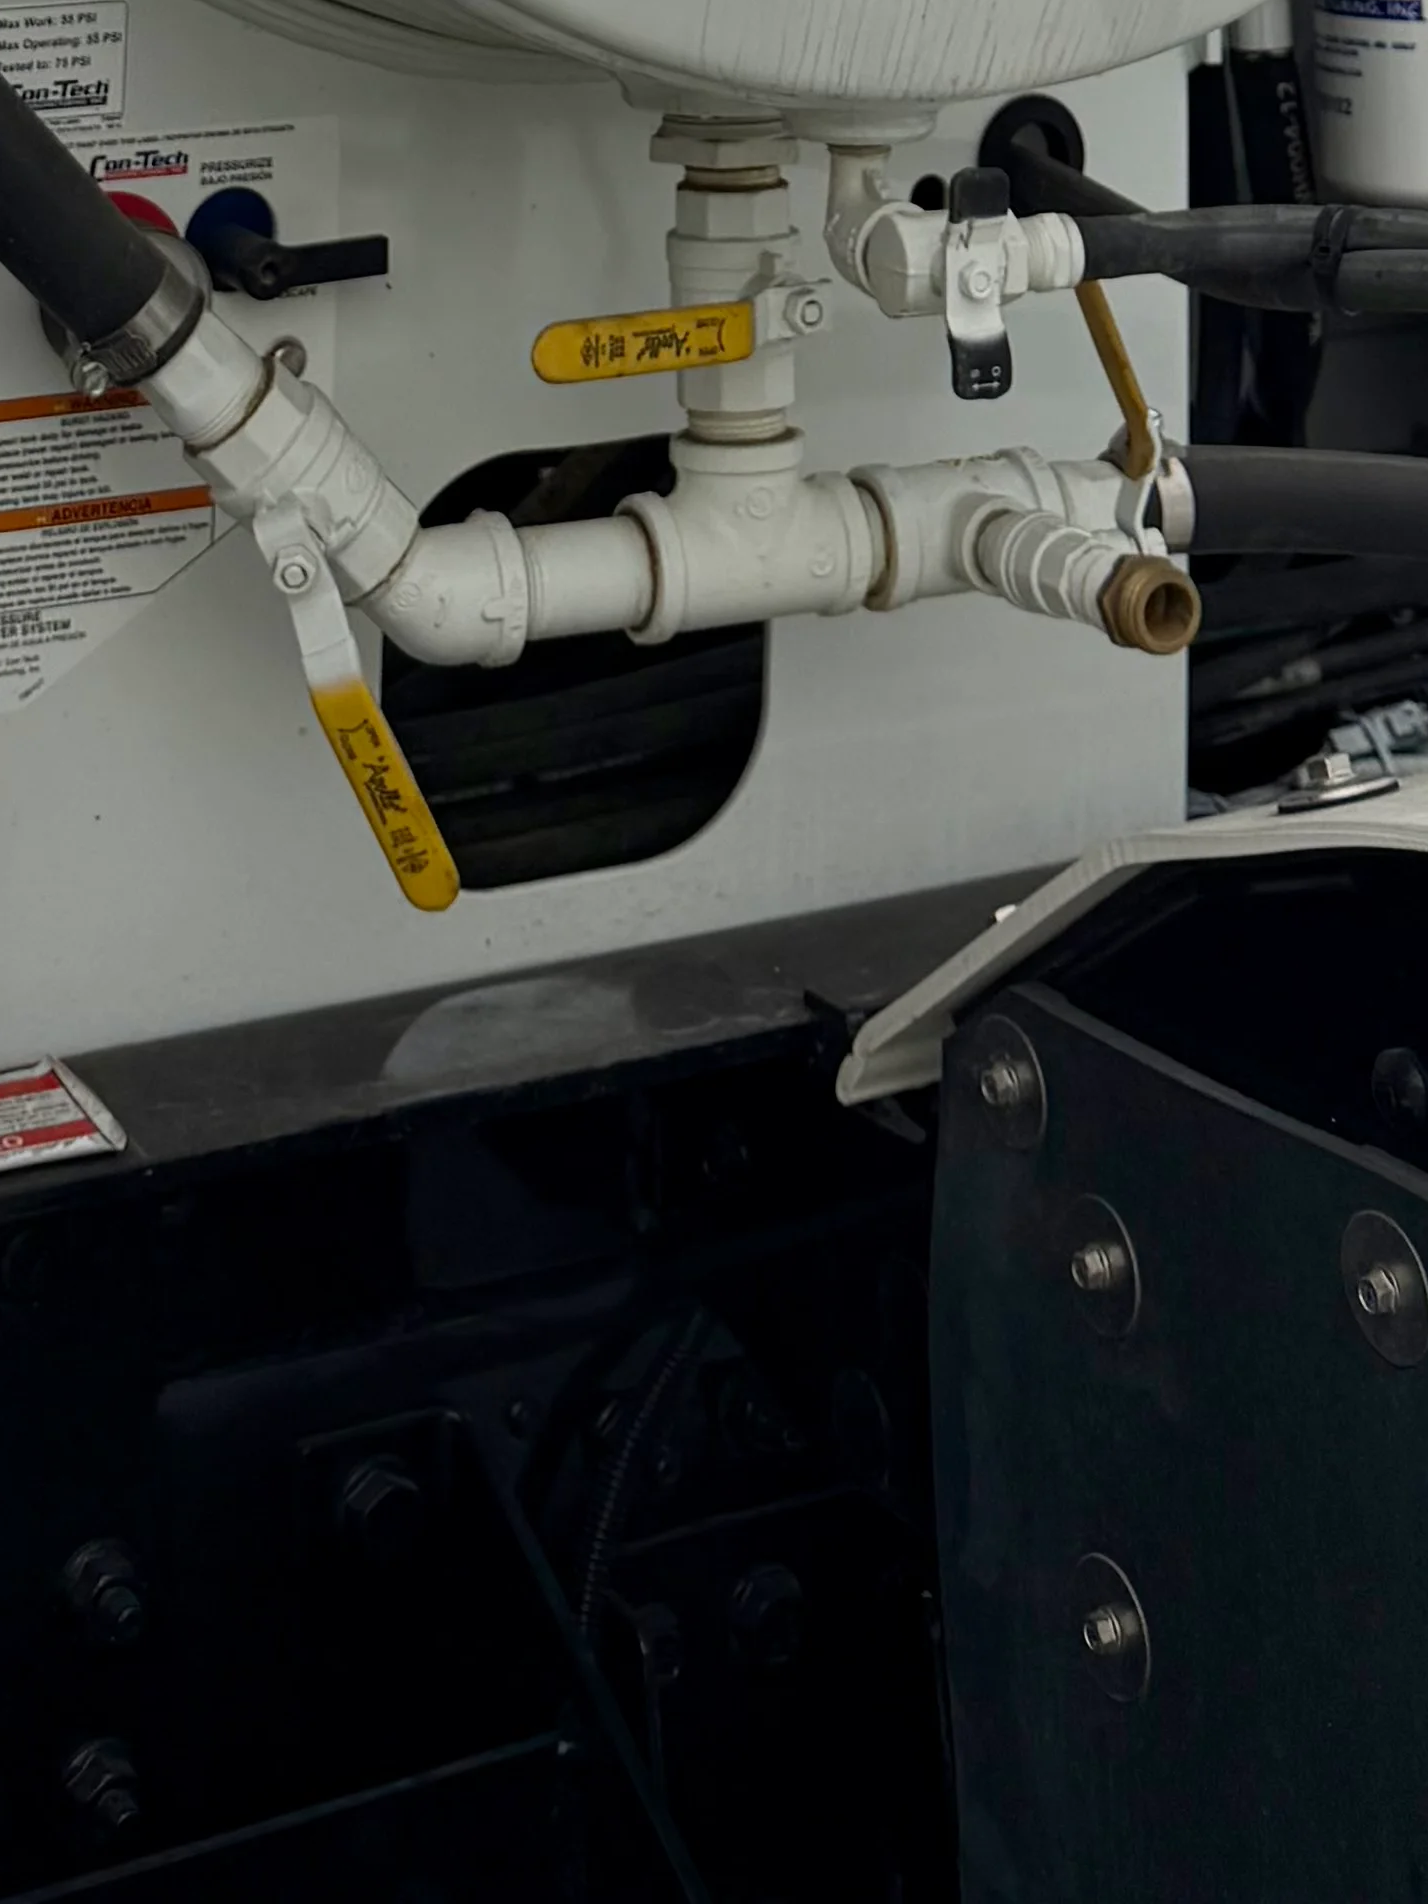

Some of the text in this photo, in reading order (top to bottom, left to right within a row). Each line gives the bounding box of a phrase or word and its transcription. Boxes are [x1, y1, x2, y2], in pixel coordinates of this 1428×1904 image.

[77, 13, 97, 23] PSI
[103, 32, 122, 42] PSI
[72, 56, 91, 67] PSI
[12, 80, 109, 100] on-Tech
[89, 150, 188, 182] Con-Tech
[200, 156, 273, 173] PRESSURIZE
[52, 500, 151, 521] ADVERTENCIA
[22, 620, 71, 637] SYSTEM
